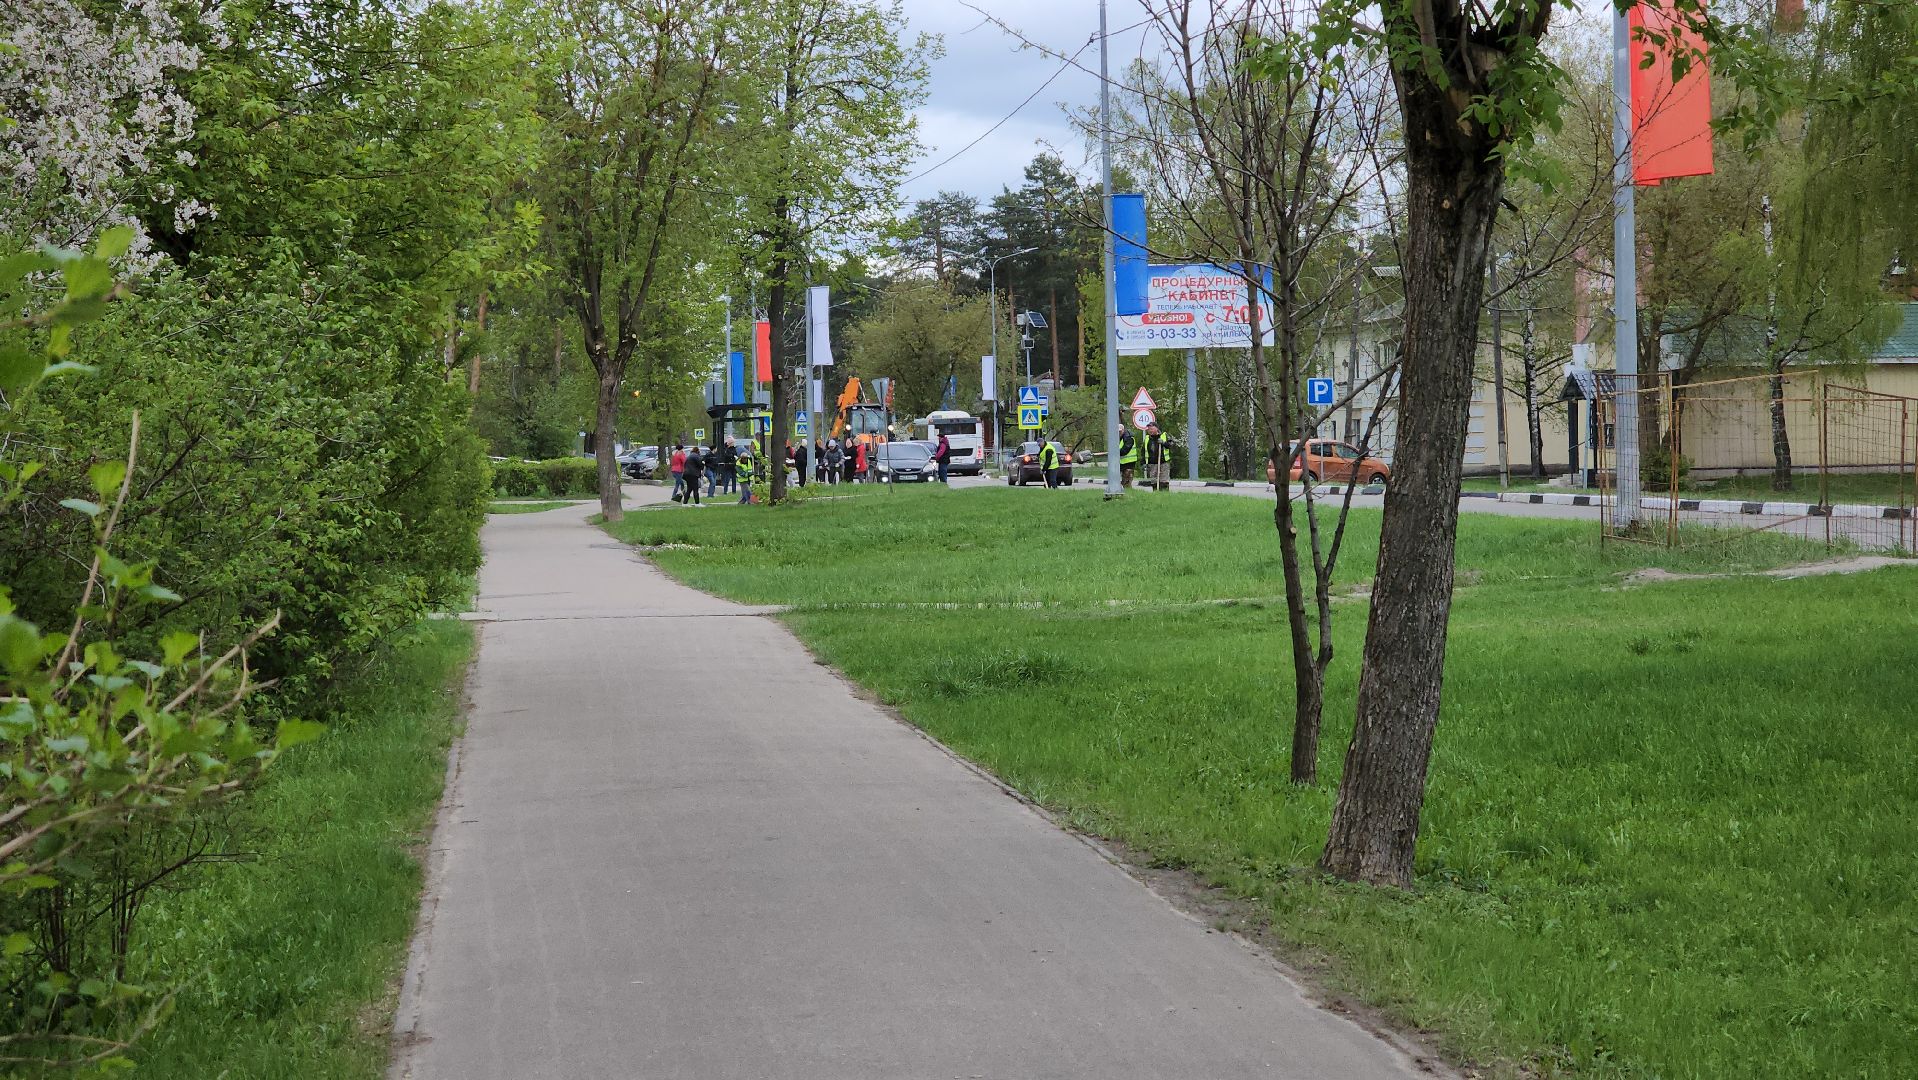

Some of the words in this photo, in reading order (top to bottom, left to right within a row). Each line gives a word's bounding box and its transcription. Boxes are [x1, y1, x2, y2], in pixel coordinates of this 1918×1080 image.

[1168, 289, 1237, 301] КАБИНЕТ
[1147, 327, 1197, 339] 3-03-33
[1138, 414, 1150, 423] 40
